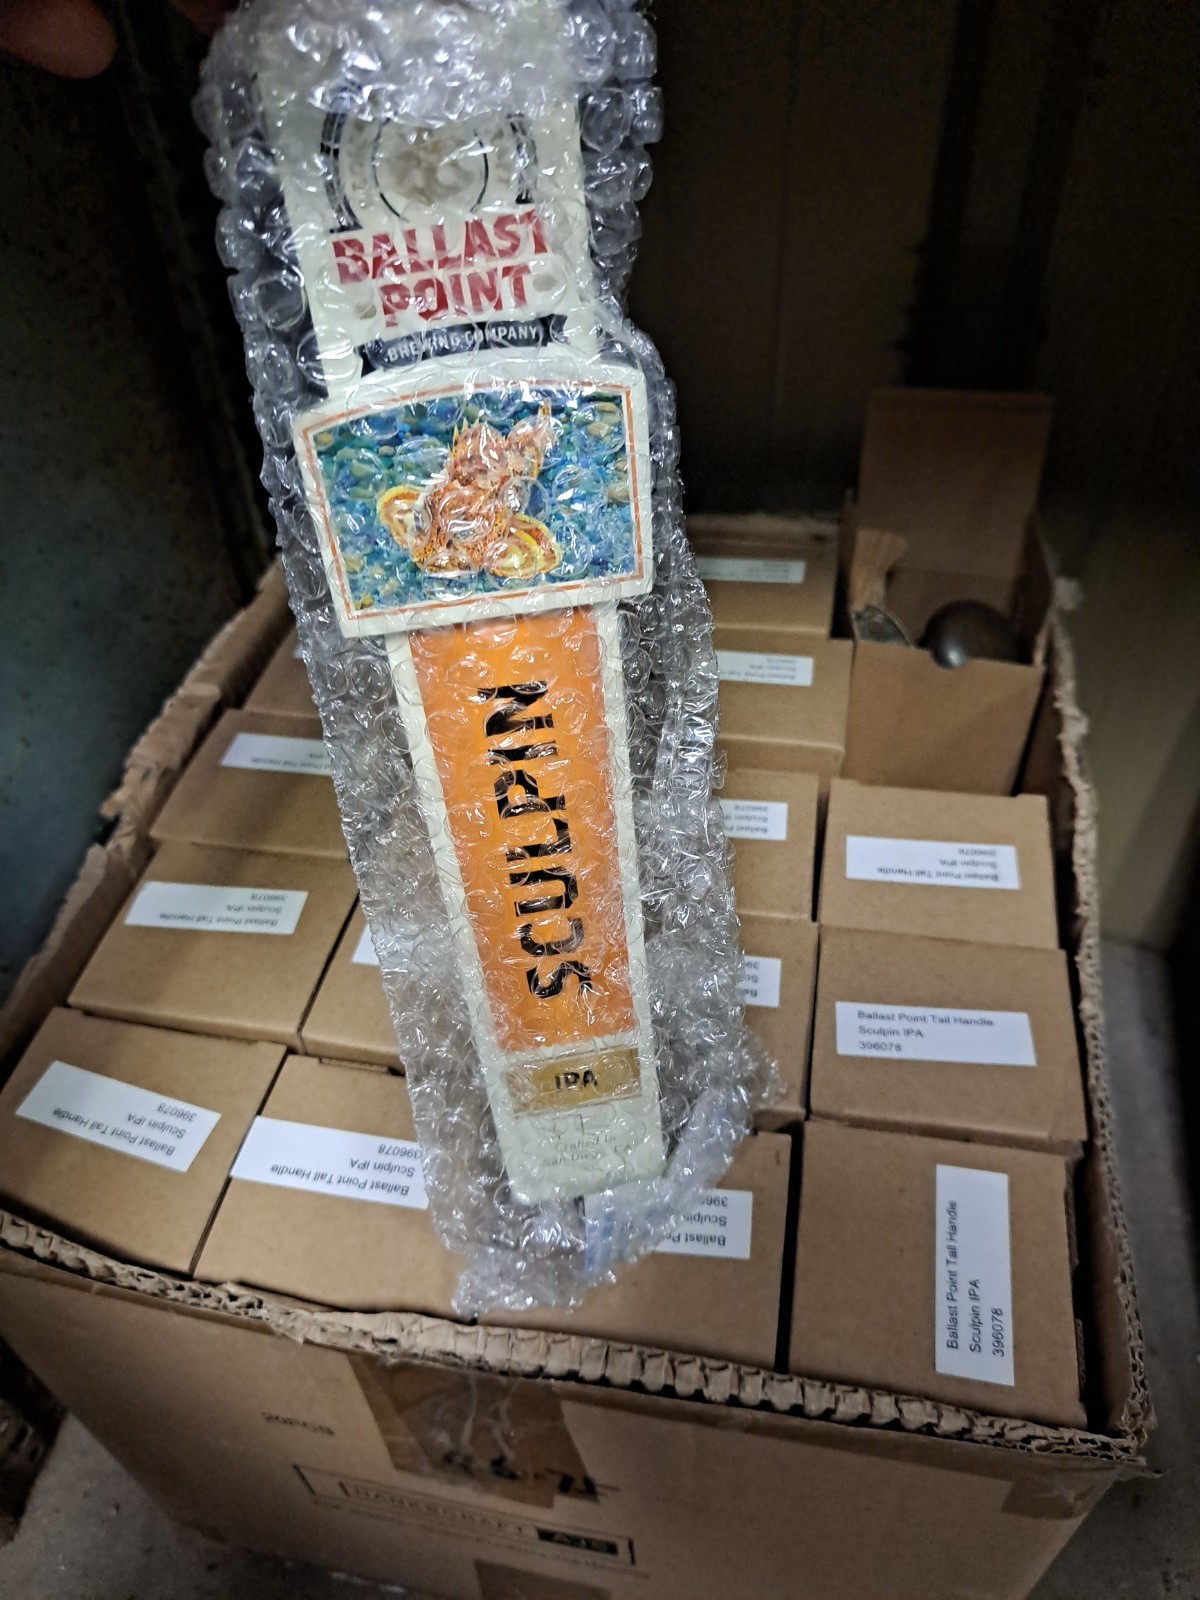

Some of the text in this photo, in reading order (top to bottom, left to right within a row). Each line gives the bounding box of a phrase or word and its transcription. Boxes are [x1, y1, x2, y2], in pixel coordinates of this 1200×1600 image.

[332, 209, 548, 284] BALLAST
[379, 263, 533, 328] POINT
[387, 325, 539, 363] BREWING COMPANY
[478, 679, 593, 1000] SCULPIN
[857, 1010, 994, 1026] Ballast Point Tall Handle
[858, 1025, 924, 1038] Sculpin IPA
[859, 1041, 902, 1052] 396078
[554, 1069, 598, 1092] IPA
[127, 1112, 187, 1140] Sculpin IPA
[157, 1102, 198, 1122] 396078
[53, 1107, 176, 1156] Ballast Point Tall Handle
[378, 1144, 422, 1159] 396078
[271, 1164, 410, 1196] Ballast Point Tall Handle
[350, 1158, 416, 1178] Sculpin IPA
[701, 1196, 728, 1206] 396
[685, 1232, 726, 1246] Ballast
[946, 1200, 959, 1350] Ballast Point Tall Handle
[968, 1278, 983, 1354] Sculpin IPA
[991, 1308, 1004, 1358] 396078
